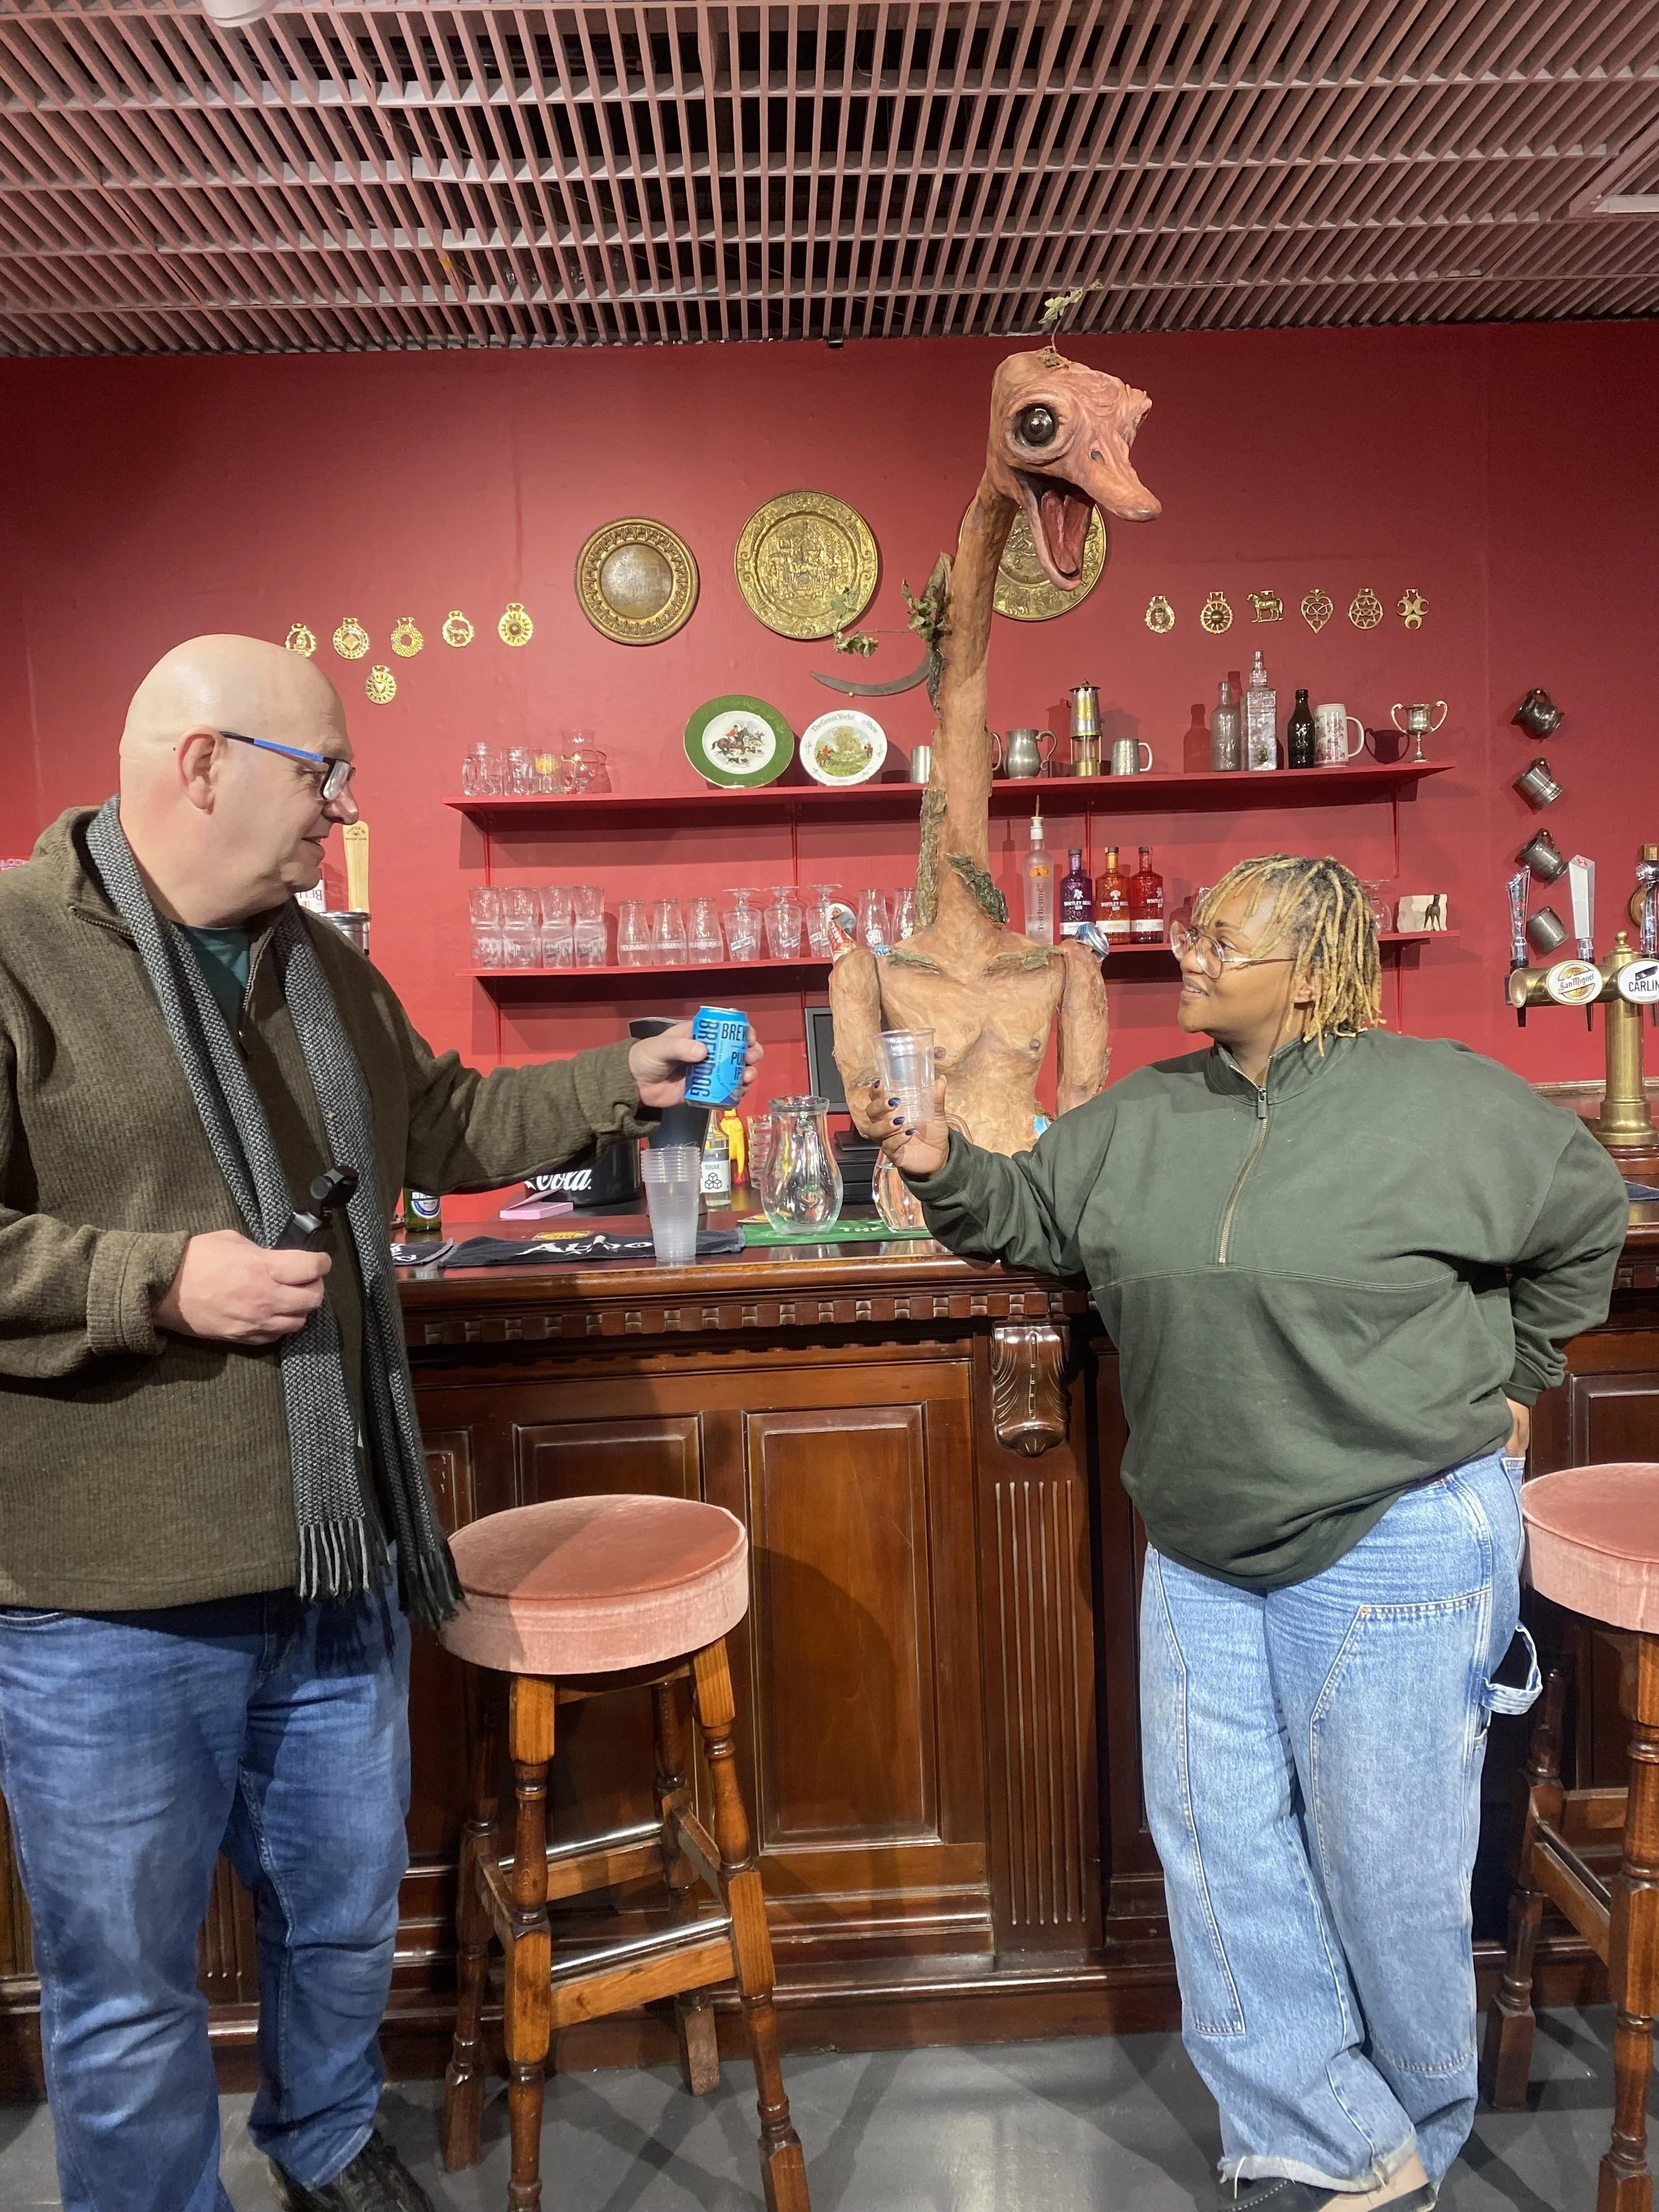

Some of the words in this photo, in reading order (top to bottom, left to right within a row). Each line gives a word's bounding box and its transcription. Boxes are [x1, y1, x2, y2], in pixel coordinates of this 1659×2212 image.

[811, 722, 822, 733] The
[820, 715, 838, 726] Great
[865, 720, 878, 733] Show
[1558, 982, 1573, 992] San
[1571, 973, 1594, 986] Miguel
